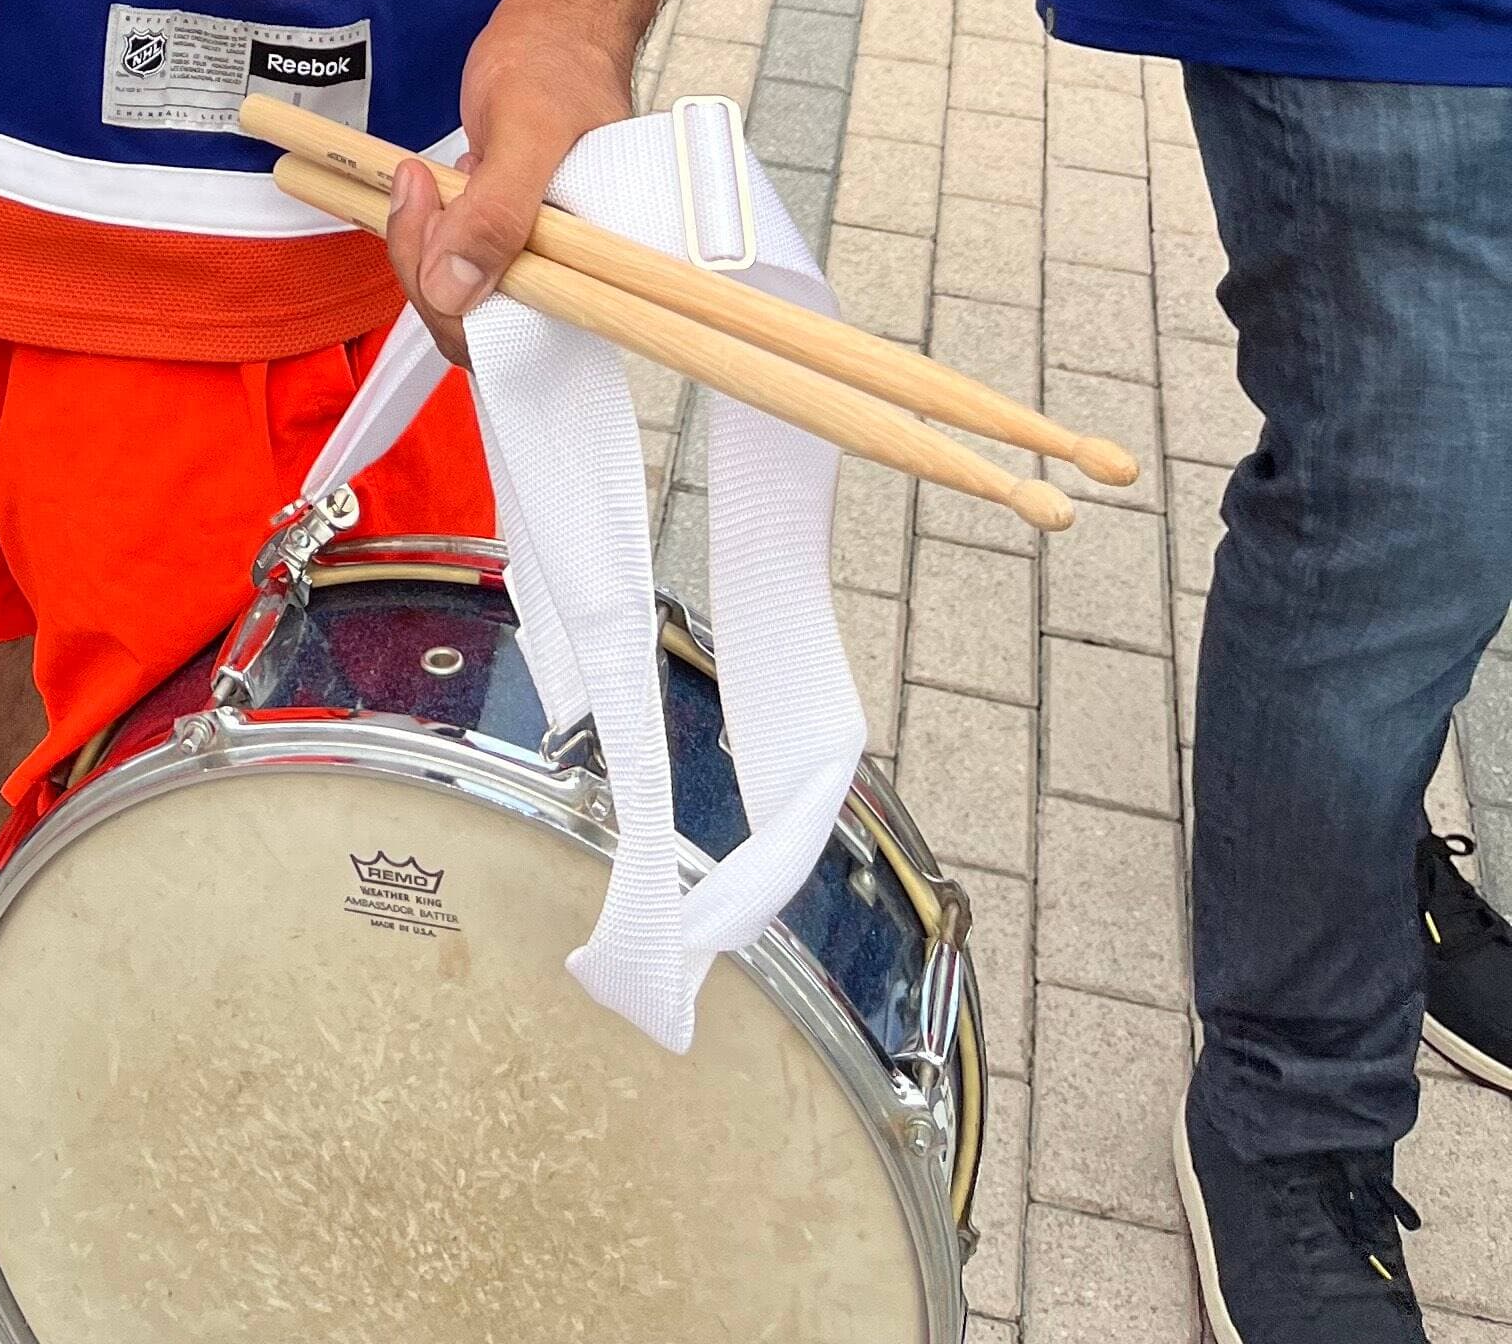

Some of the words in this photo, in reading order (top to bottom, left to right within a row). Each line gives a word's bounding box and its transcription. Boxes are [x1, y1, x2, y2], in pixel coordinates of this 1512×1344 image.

[125, 15, 198, 25] OFFICIAL
[131, 42, 161, 67] NHL
[267, 53, 351, 77] Reebok
[368, 866, 428, 887] REMO
[360, 885, 410, 903] WEATHER
[415, 895, 442, 908] KING
[344, 896, 415, 916] AMBASSADOR
[420, 909, 459, 923] BATTER
[370, 919, 395, 930] MADE
[399, 923, 409, 932] IN
